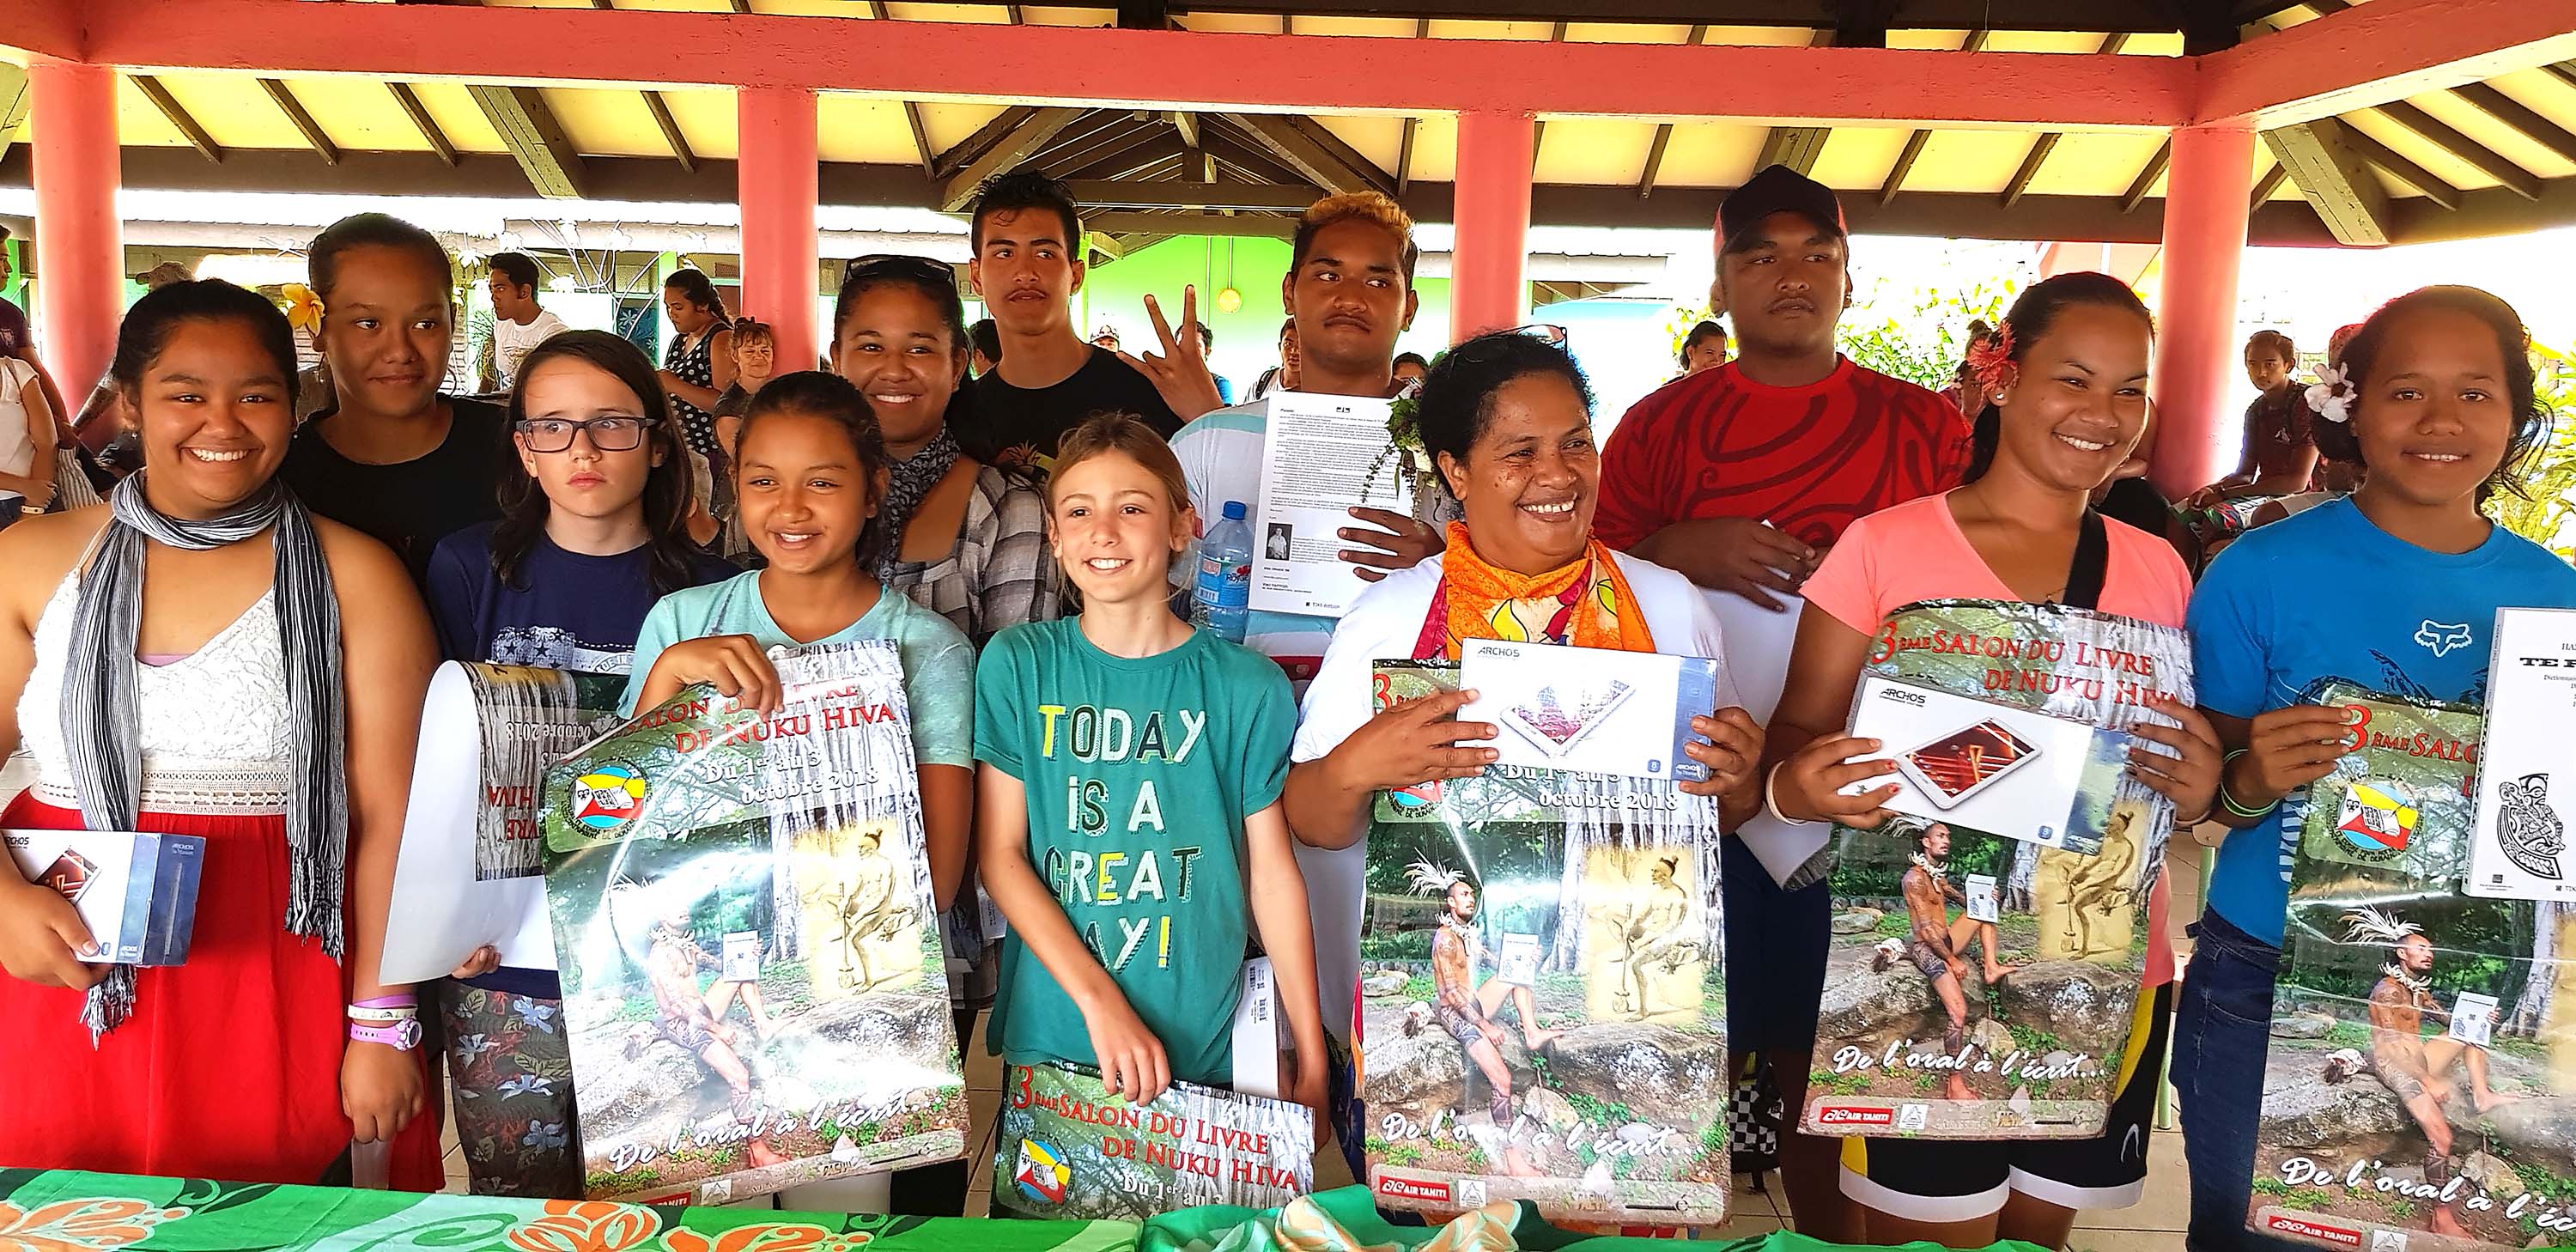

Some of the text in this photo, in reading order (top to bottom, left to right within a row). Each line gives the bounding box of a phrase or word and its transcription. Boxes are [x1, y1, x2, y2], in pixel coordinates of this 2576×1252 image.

[1478, 646, 1521, 658] ARCHOS
[1932, 629, 2022, 659] SALON
[2026, 639, 2065, 663] DU
[2075, 642, 2154, 677] LIVRE
[2519, 657, 2559, 667] TE
[1880, 688, 1927, 704] ARCHOS
[1984, 668, 2014, 691] DE
[2018, 668, 2104, 702] NUKU
[505, 721, 592, 742] octobre 2018
[627, 695, 744, 734] SALON D
[725, 714, 811, 747] NUKU
[823, 702, 897, 732] HIVA
[1037, 704, 1207, 767] TODAY
[2409, 732, 2479, 765] SALO
[704, 759, 738, 785] Du
[776, 752, 805, 773] au
[809, 750, 823, 768] 3
[486, 785, 534, 811] HIVA
[741, 767, 879, 806] octobre 2018
[1538, 792, 1679, 811] octobre 2018
[1127, 780, 1168, 835] A
[5, 836, 31, 846] RCHOS
[506, 818, 541, 841] VRE
[1042, 844, 1204, 907] GREAT
[1084, 915, 1172, 975] AY!
[1832, 1044, 1874, 1075] De
[1973, 1051, 1993, 1073] à
[1058, 1094, 1139, 1130] SALON
[1151, 1111, 1188, 1139] DU
[1196, 1119, 1269, 1155] LIVRE
[1381, 1111, 1421, 1143] De
[1531, 1123, 1554, 1147] à
[1845, 1112, 1891, 1122] AIR TAHITI
[608, 1140, 661, 1174] De
[775, 1115, 798, 1137] à
[1103, 1136, 1299, 1192] DE NUKU HIVA
[1123, 1176, 1150, 1200] Du
[1403, 1185, 1448, 1199] AIR TAHITI
[2280, 1157, 2336, 1187] De
[2466, 1187, 2493, 1212] à
[2303, 1226, 2358, 1245] AIR TAHITI
